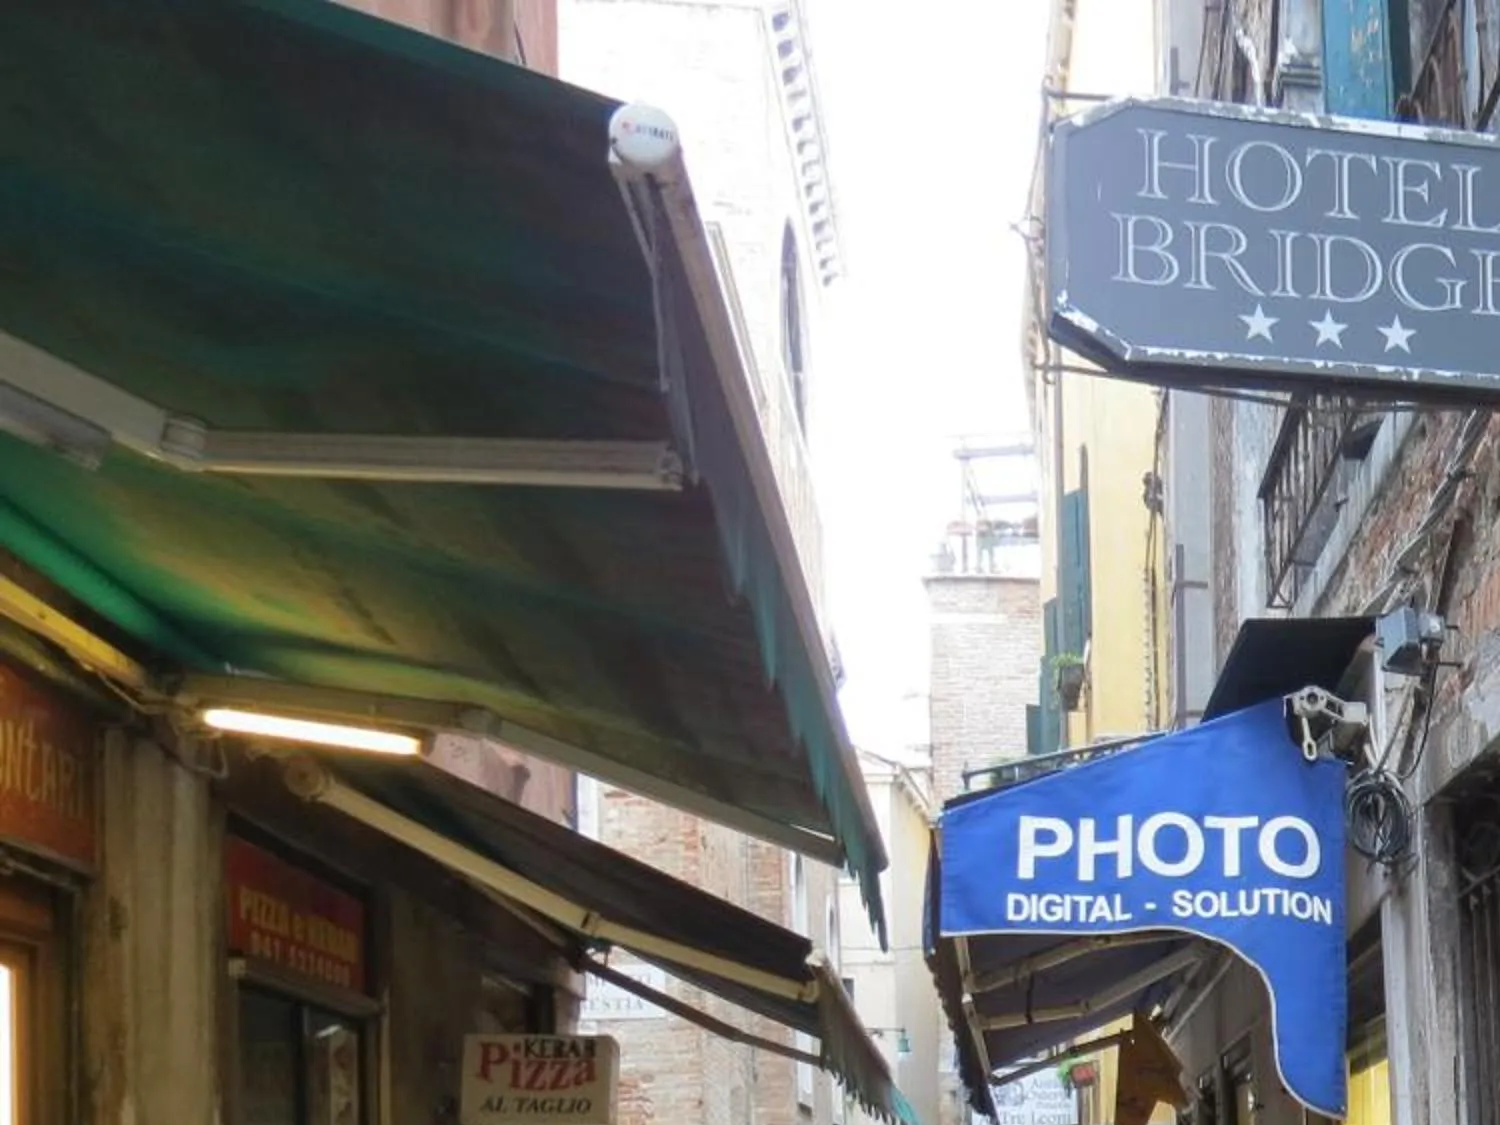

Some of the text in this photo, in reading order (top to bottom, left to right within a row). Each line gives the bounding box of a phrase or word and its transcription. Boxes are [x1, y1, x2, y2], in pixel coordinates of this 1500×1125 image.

[1017, 811, 1321, 881] PHOTO
[1006, 892, 1133, 923] DIGITAL
[1171, 887, 1333, 925] SOLUTION
[476, 1040, 598, 1091] Pizza
[479, 1095, 593, 1115] AL TAGLIO
